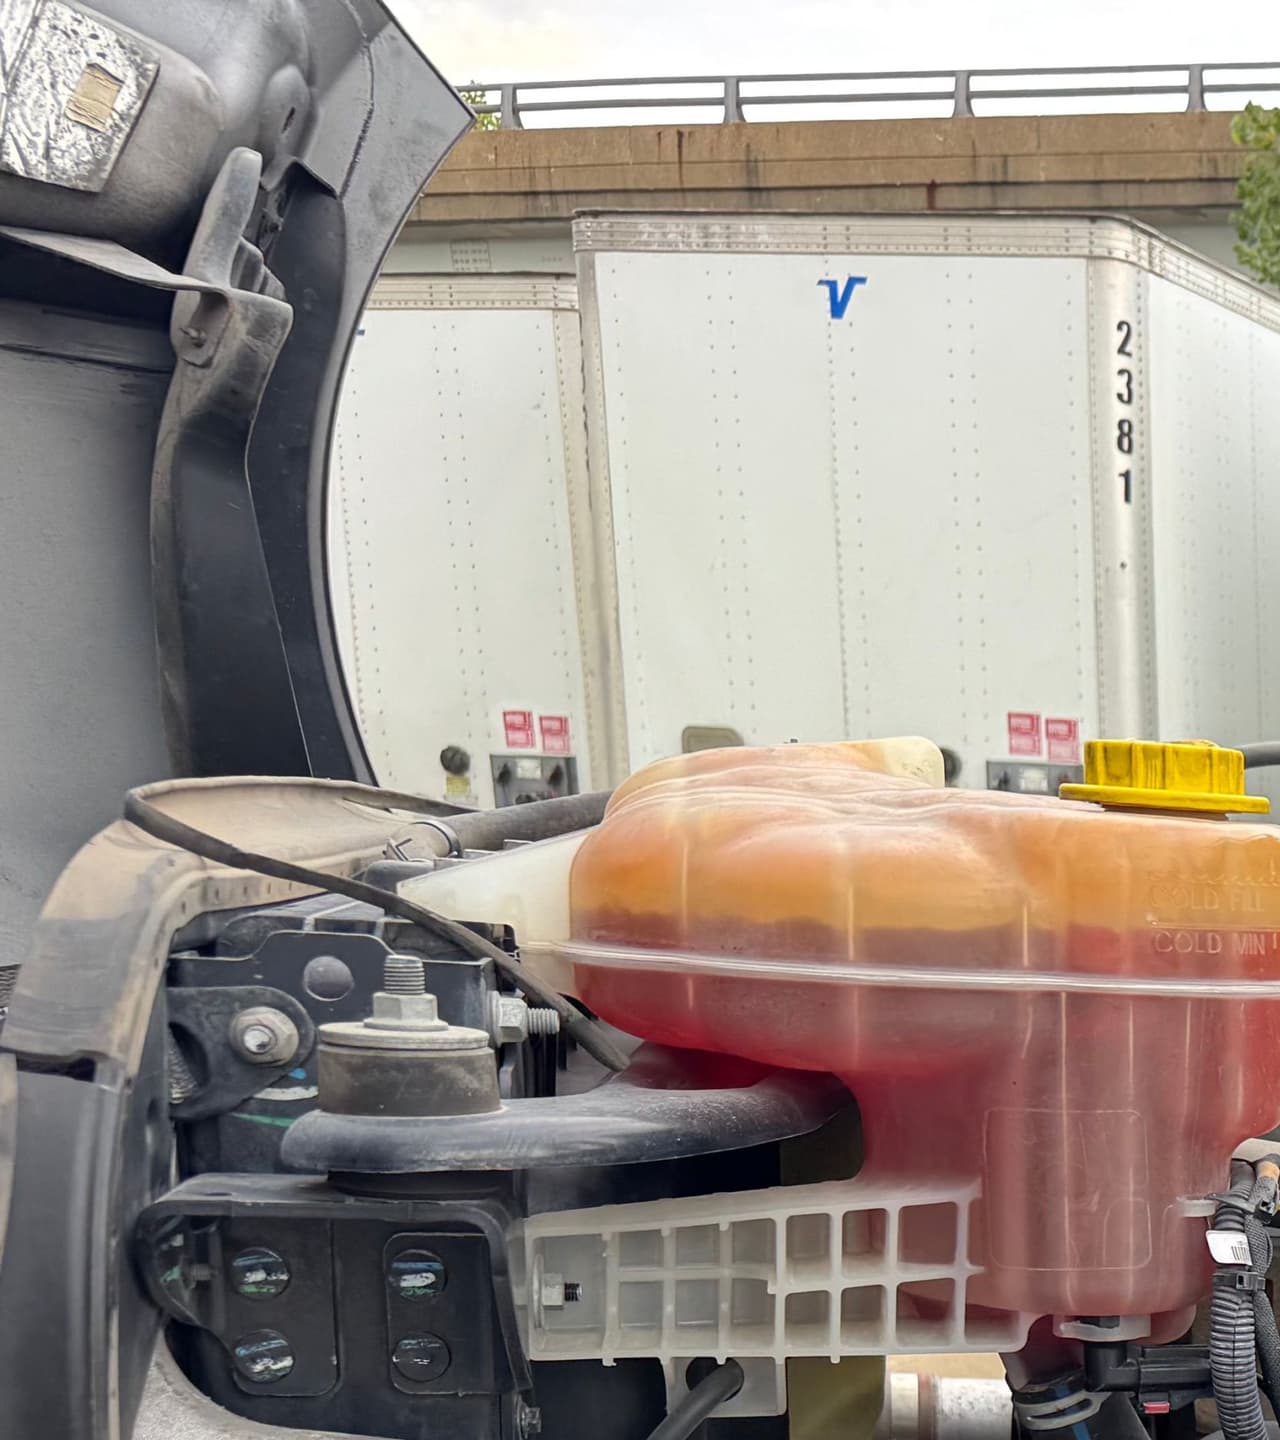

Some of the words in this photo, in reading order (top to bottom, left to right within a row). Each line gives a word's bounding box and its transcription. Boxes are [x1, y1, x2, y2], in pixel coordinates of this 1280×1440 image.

[1115, 320, 1134, 504] 2381
[1155, 932, 1222, 954] COLD
[1232, 933, 1266, 955] MIN
